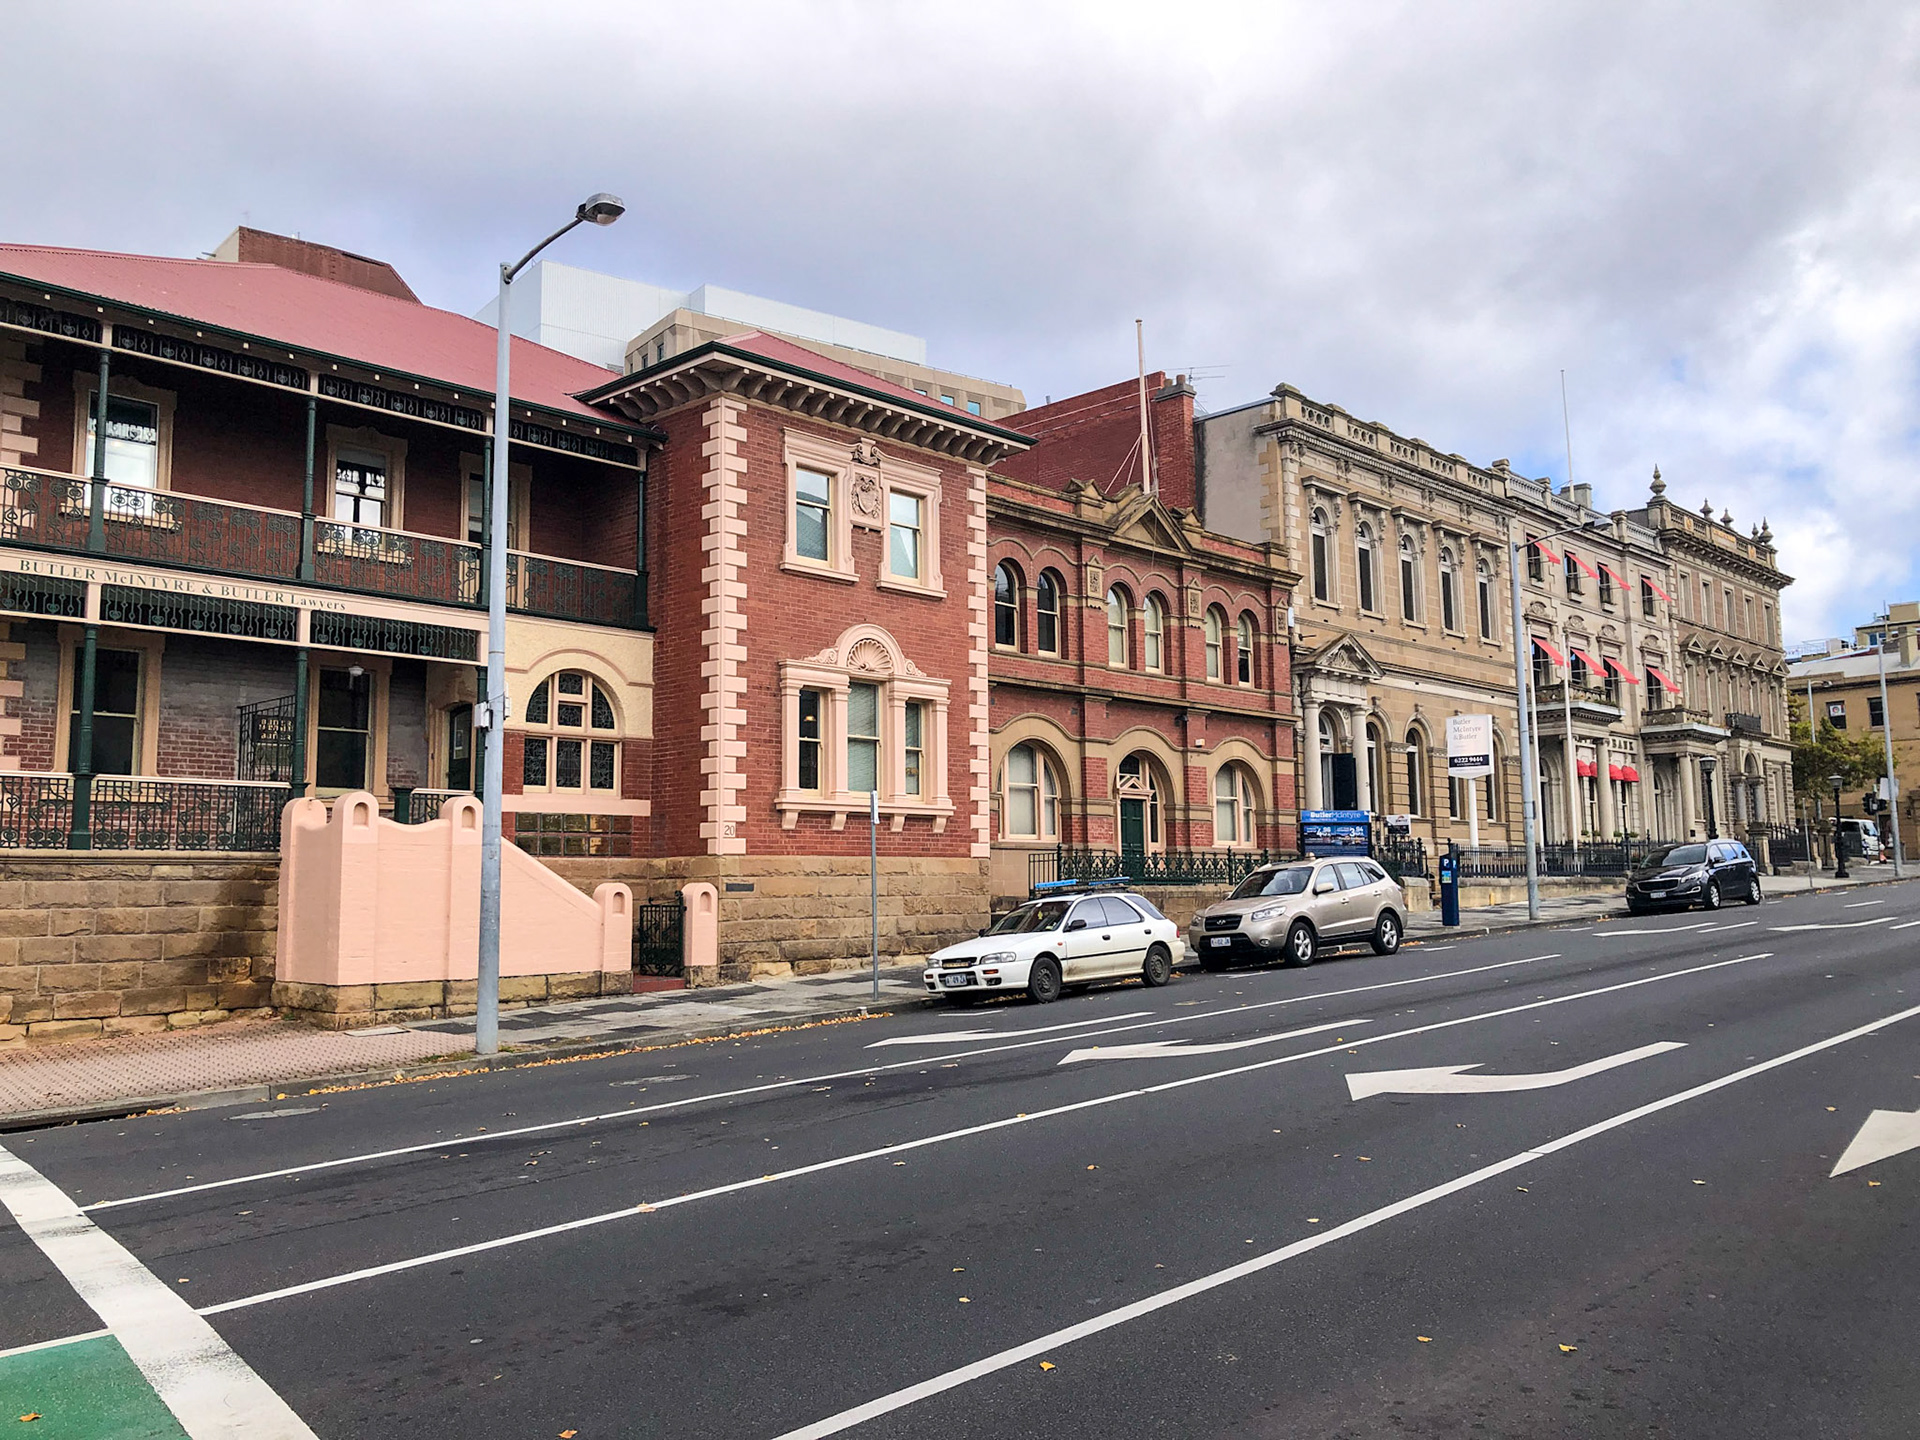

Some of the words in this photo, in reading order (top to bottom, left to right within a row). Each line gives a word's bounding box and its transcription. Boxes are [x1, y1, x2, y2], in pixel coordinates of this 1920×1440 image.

[20, 560, 96, 580] BUTLER
[104, 571, 195, 592] McINTYRE
[202, 584, 213, 595] &
[221, 586, 285, 603] BUTLER
[291, 594, 346, 611] Lawyers
[1453, 726, 1482, 734] McIntyre
[1612, 739, 1634, 751] BANK
[724, 825, 735, 836] 20
[1443, 858, 1450, 867] P
